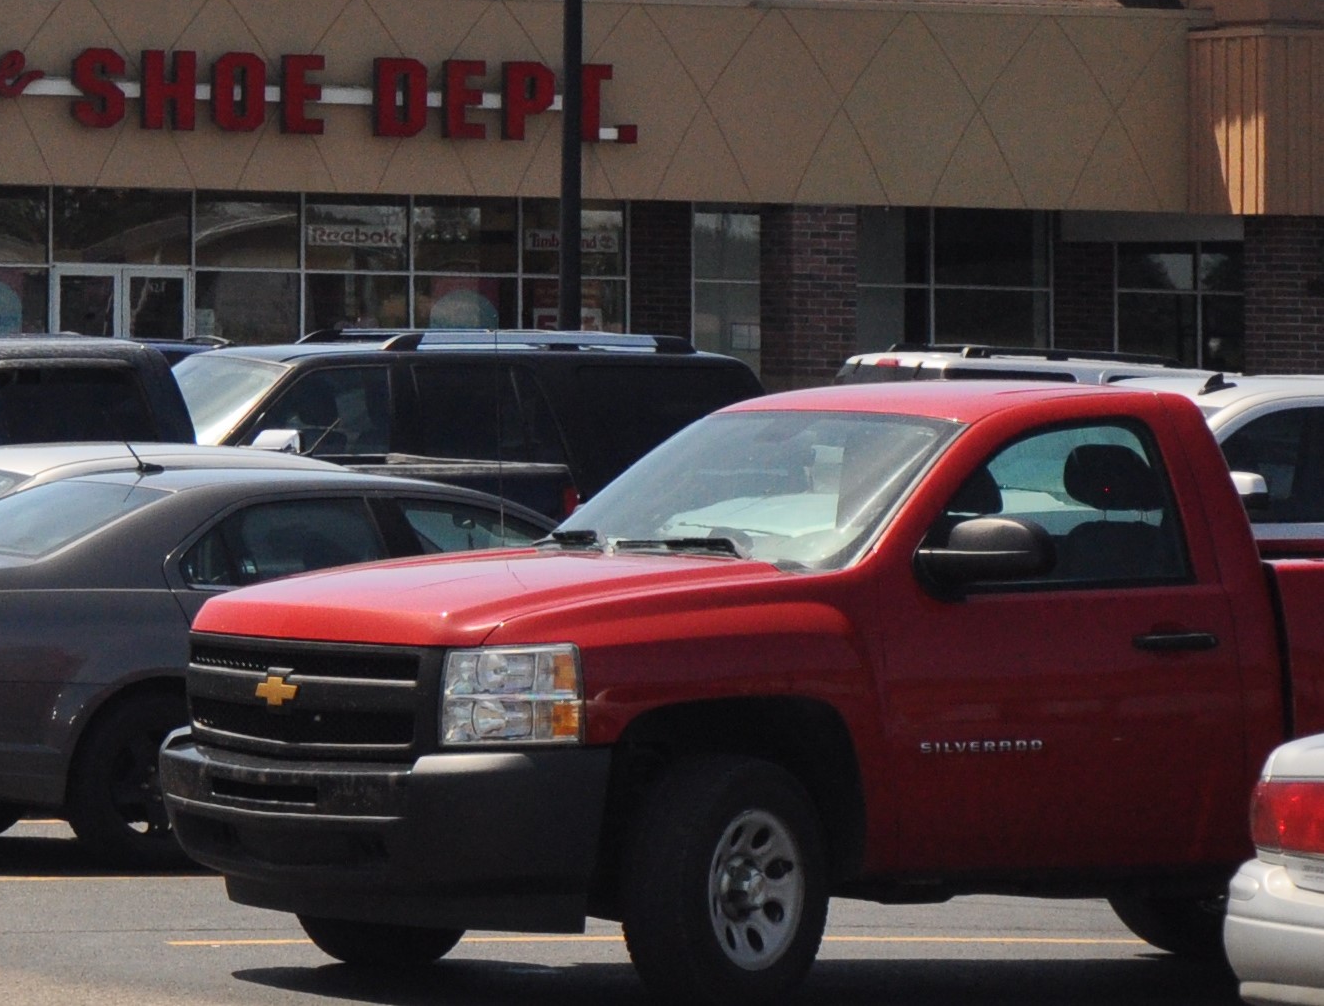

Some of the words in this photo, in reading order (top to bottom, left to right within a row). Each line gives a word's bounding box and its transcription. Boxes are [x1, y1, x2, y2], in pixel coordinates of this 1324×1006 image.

[70, 47, 326, 136] SHOE
[371, 57, 637, 145] DEPT.
[311, 226, 398, 245] Reebok
[528, 232, 597, 250] Timbnd
[919, 739, 1044, 754] SILVERADO
